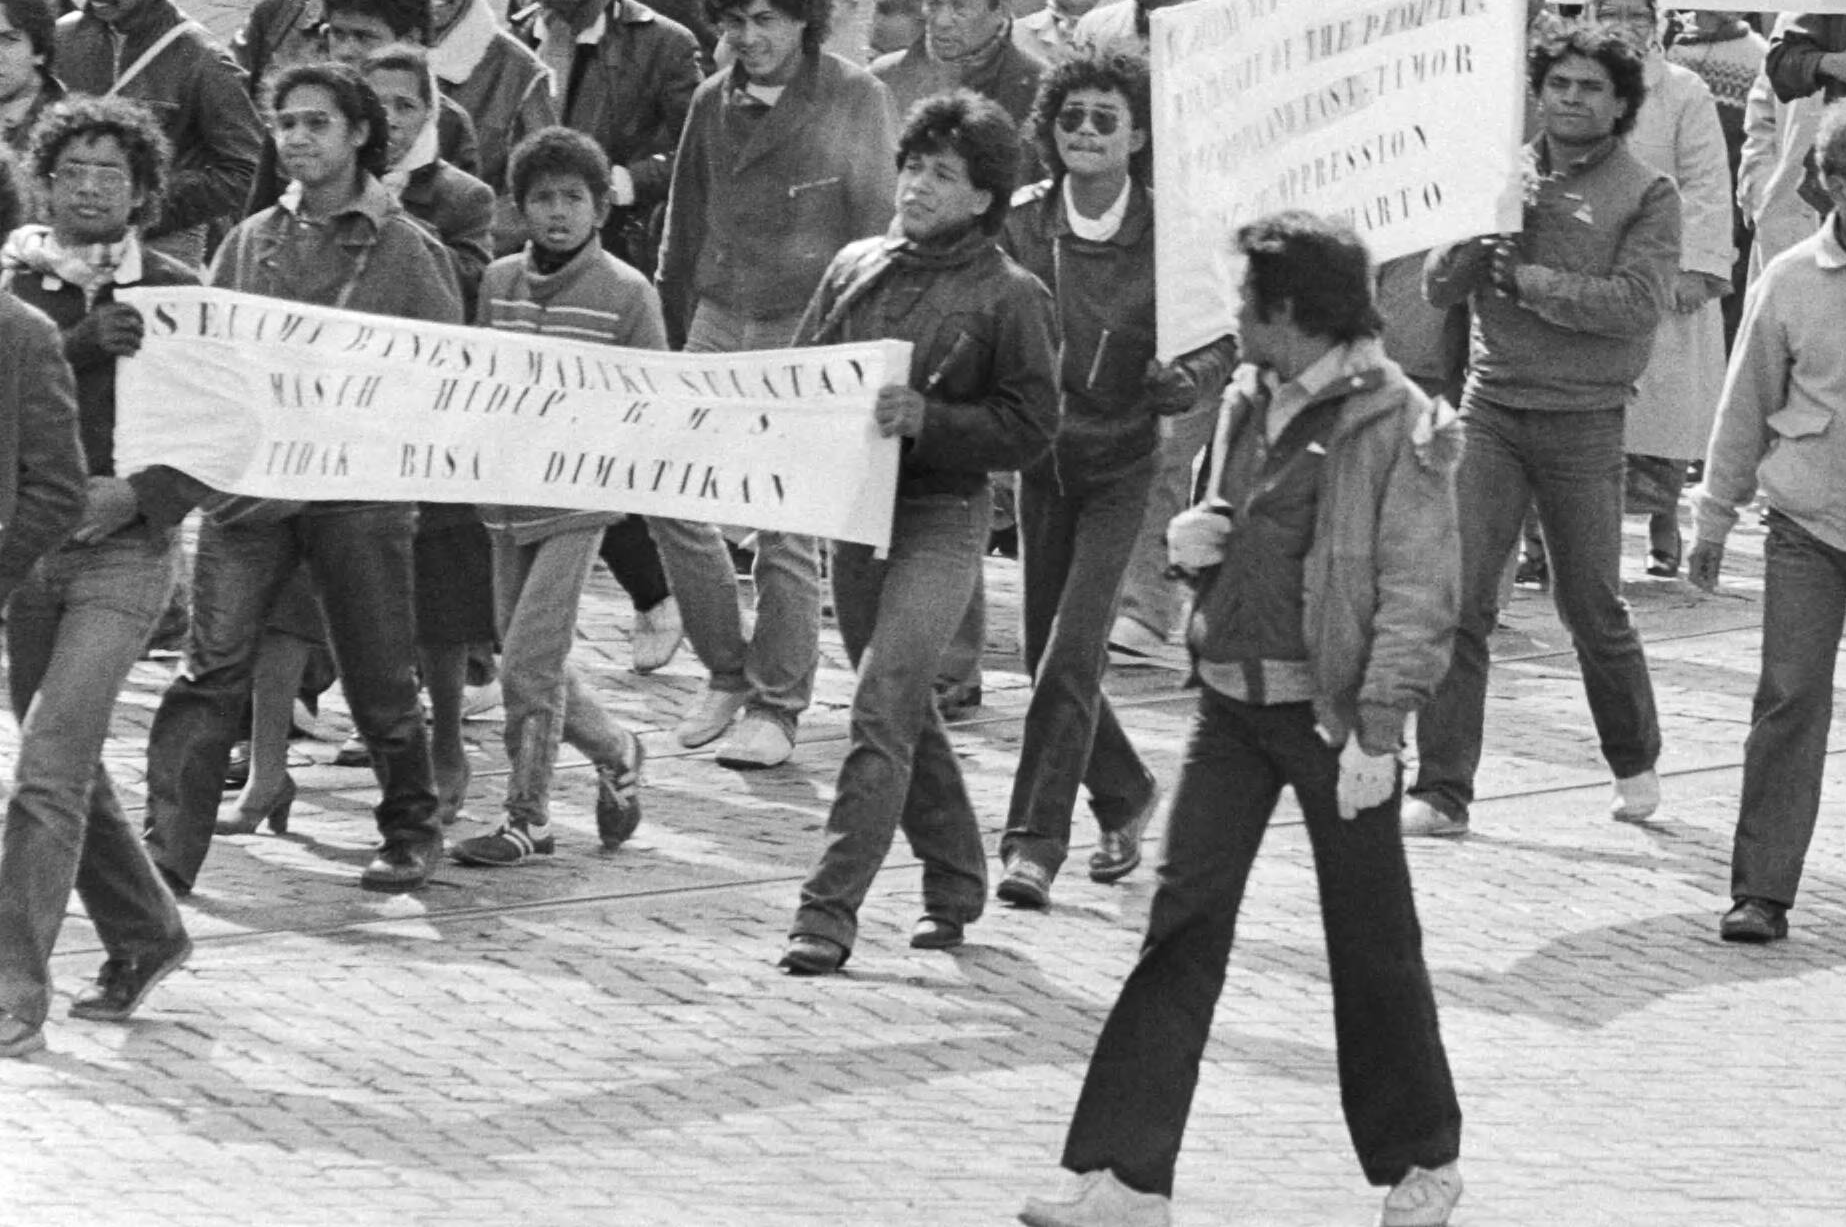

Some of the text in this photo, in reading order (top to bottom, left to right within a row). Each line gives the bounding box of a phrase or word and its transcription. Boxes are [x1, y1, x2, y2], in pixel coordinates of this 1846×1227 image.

[1277, 124, 1431, 201] OPPRESSION
[268, 371, 384, 409] MASIH
[266, 440, 351, 477] TIDAK
[399, 442, 482, 482] BISA
